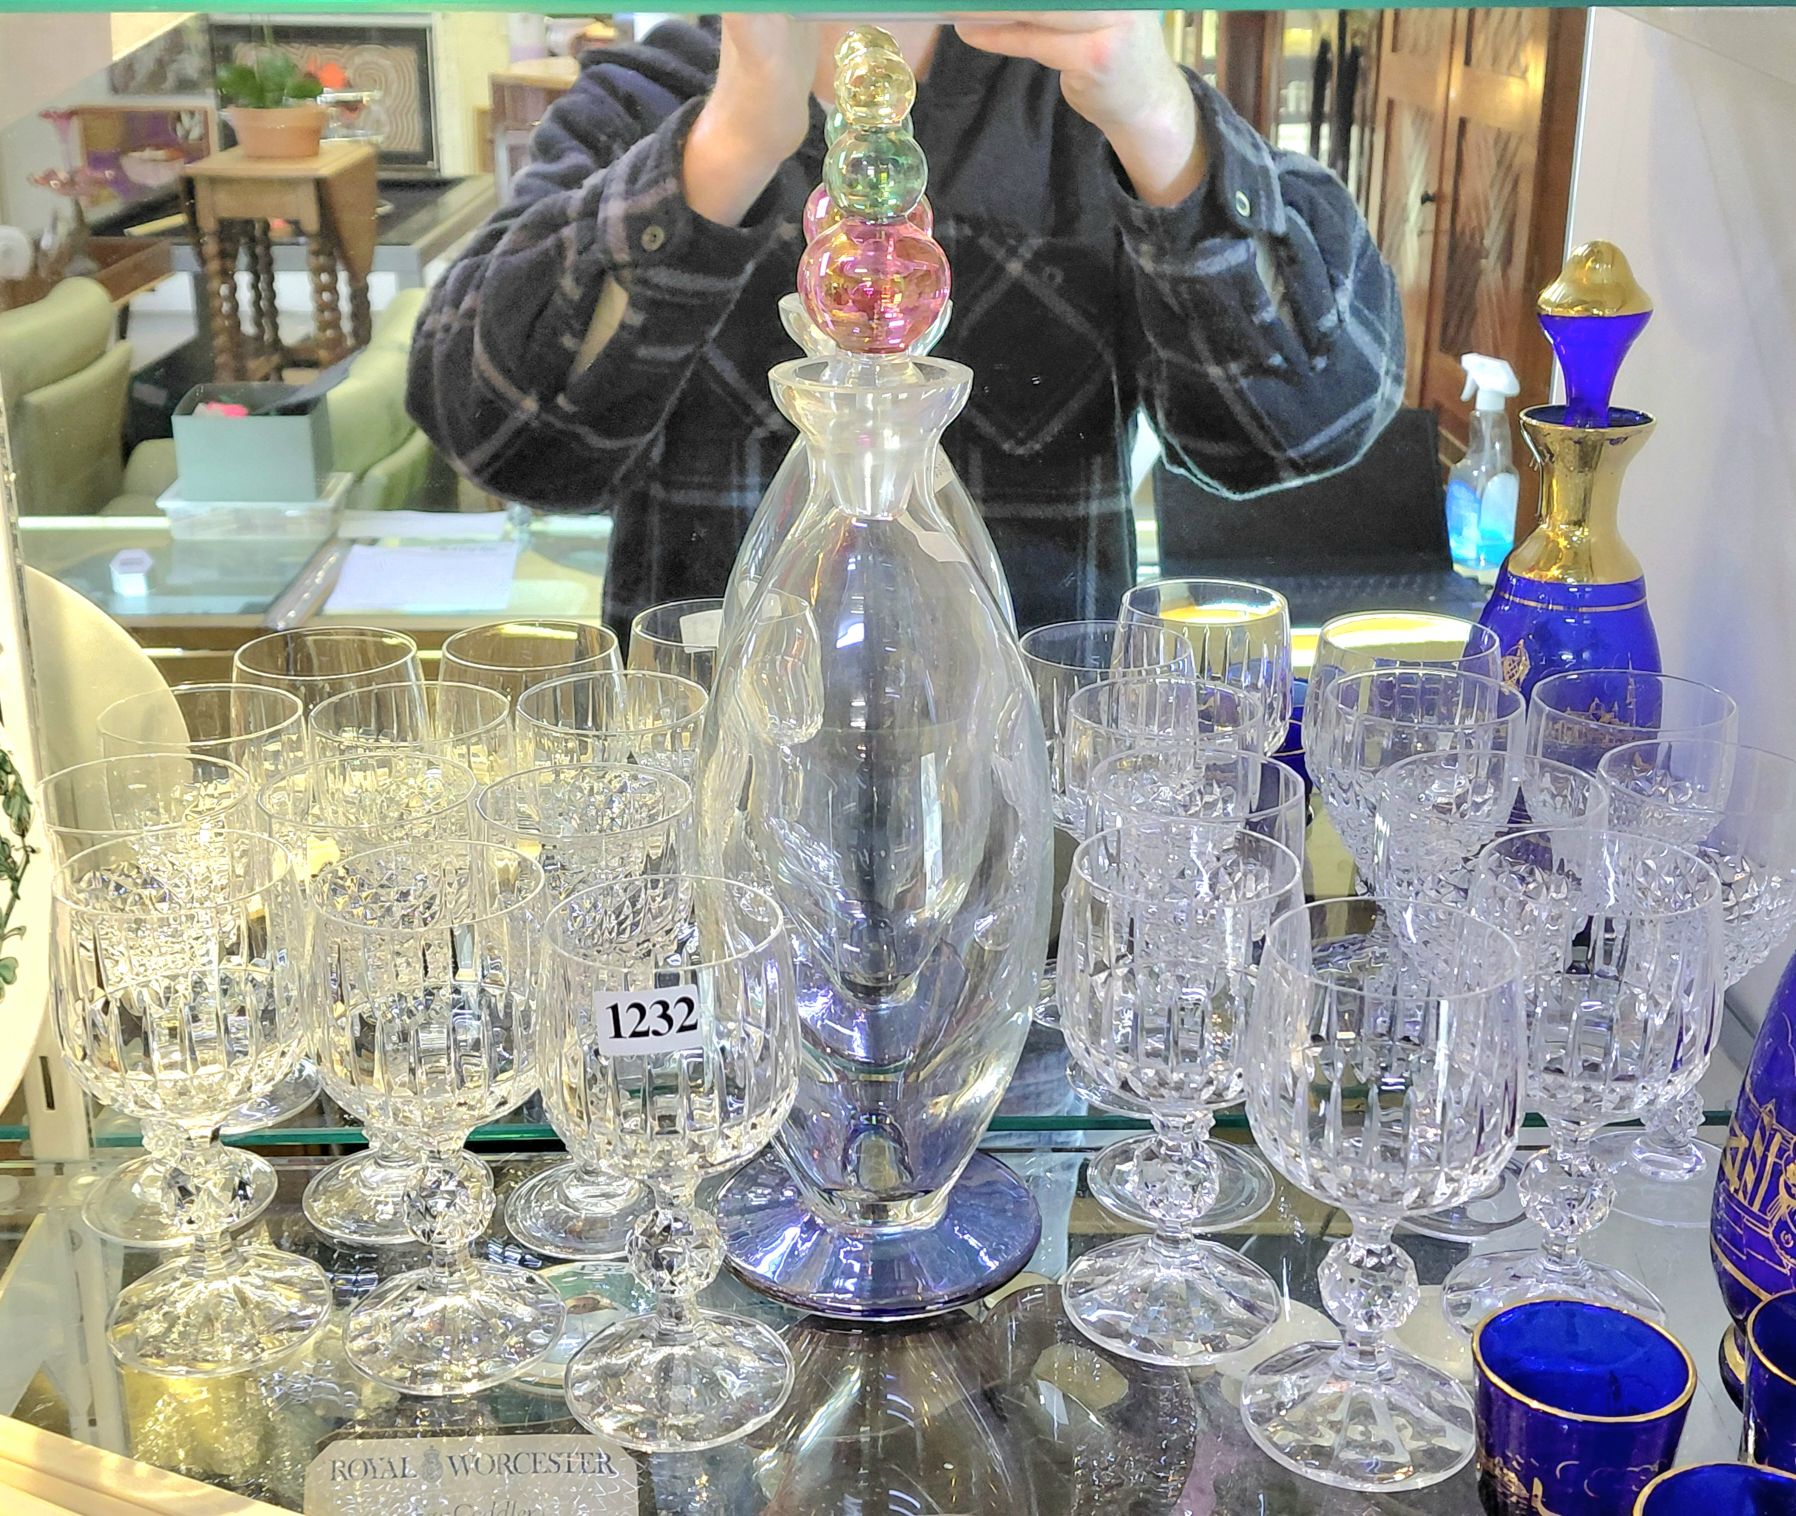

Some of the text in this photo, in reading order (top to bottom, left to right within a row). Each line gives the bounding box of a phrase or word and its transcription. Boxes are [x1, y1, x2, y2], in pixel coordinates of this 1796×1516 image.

[605, 996, 699, 1039] 1232
[330, 1451, 616, 1481] ROYAL WORCESTER
